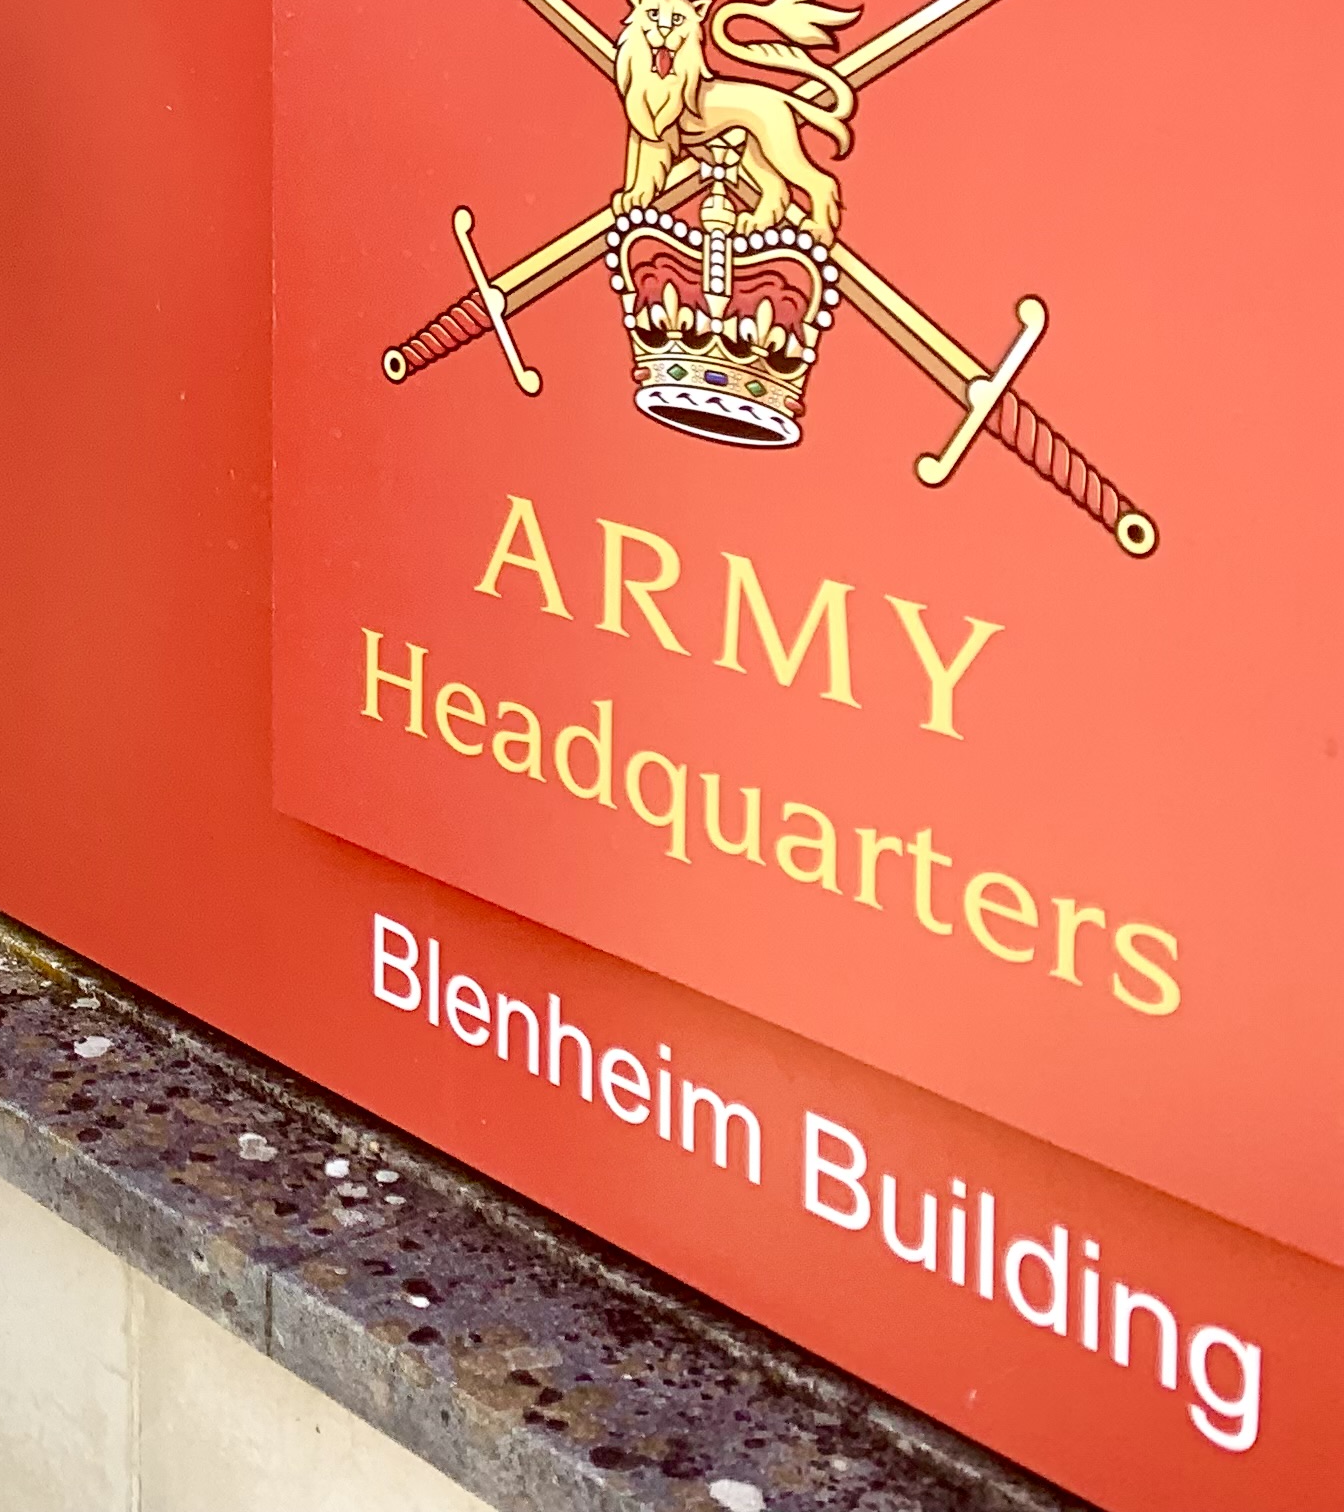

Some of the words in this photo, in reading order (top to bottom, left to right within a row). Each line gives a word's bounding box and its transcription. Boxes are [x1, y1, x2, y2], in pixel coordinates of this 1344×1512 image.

[473, 493, 1006, 741] ARMY
[359, 626, 1182, 1017] Headquarters
[372, 911, 762, 1185] Blenheim
[802, 1109, 1262, 1452] Building
